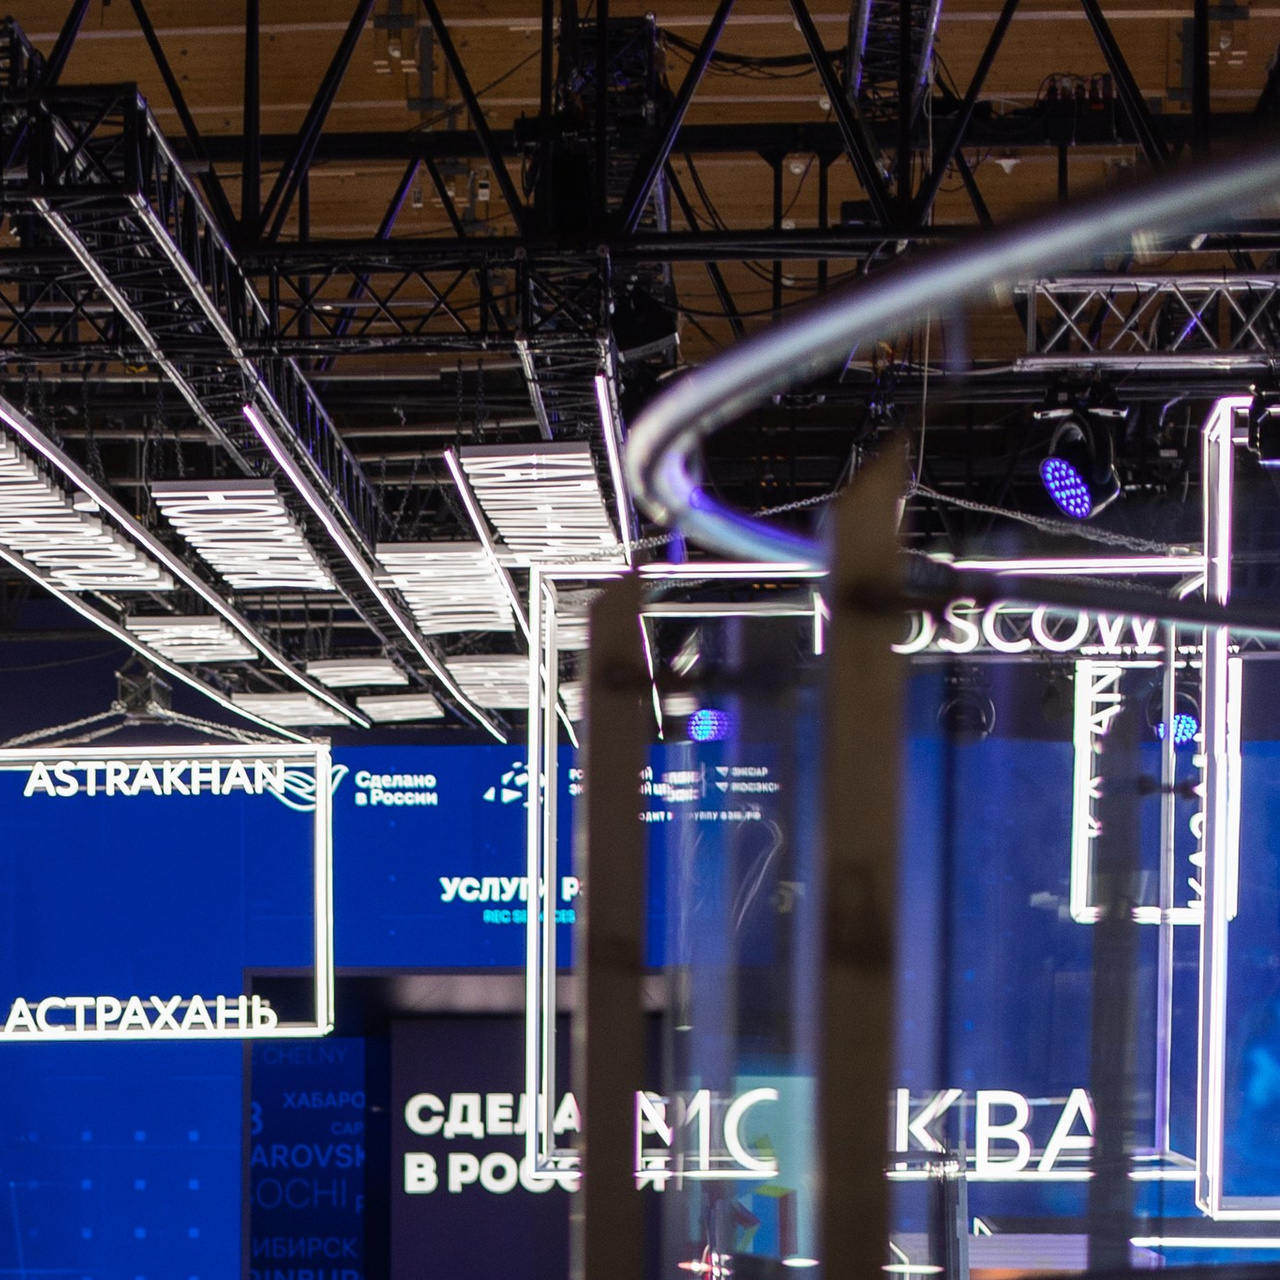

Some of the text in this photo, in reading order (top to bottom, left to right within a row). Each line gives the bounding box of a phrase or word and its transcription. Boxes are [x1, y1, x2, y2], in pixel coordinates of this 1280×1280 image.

[22, 758, 287, 798] ASTRAKHAN
[354, 771, 437, 790] Сделано
[355, 789, 439, 806] в России
[439, 876, 552, 902] УСЛУГ
[3, 994, 279, 1033] АСТРАХАНЬ
[404, 1092, 666, 1139] СДЕЛАО
[634, 1086, 1095, 1173] МОКВА
[404, 1151, 666, 1194] В РОССИ
[250, 1178, 348, 1209] OCHI
